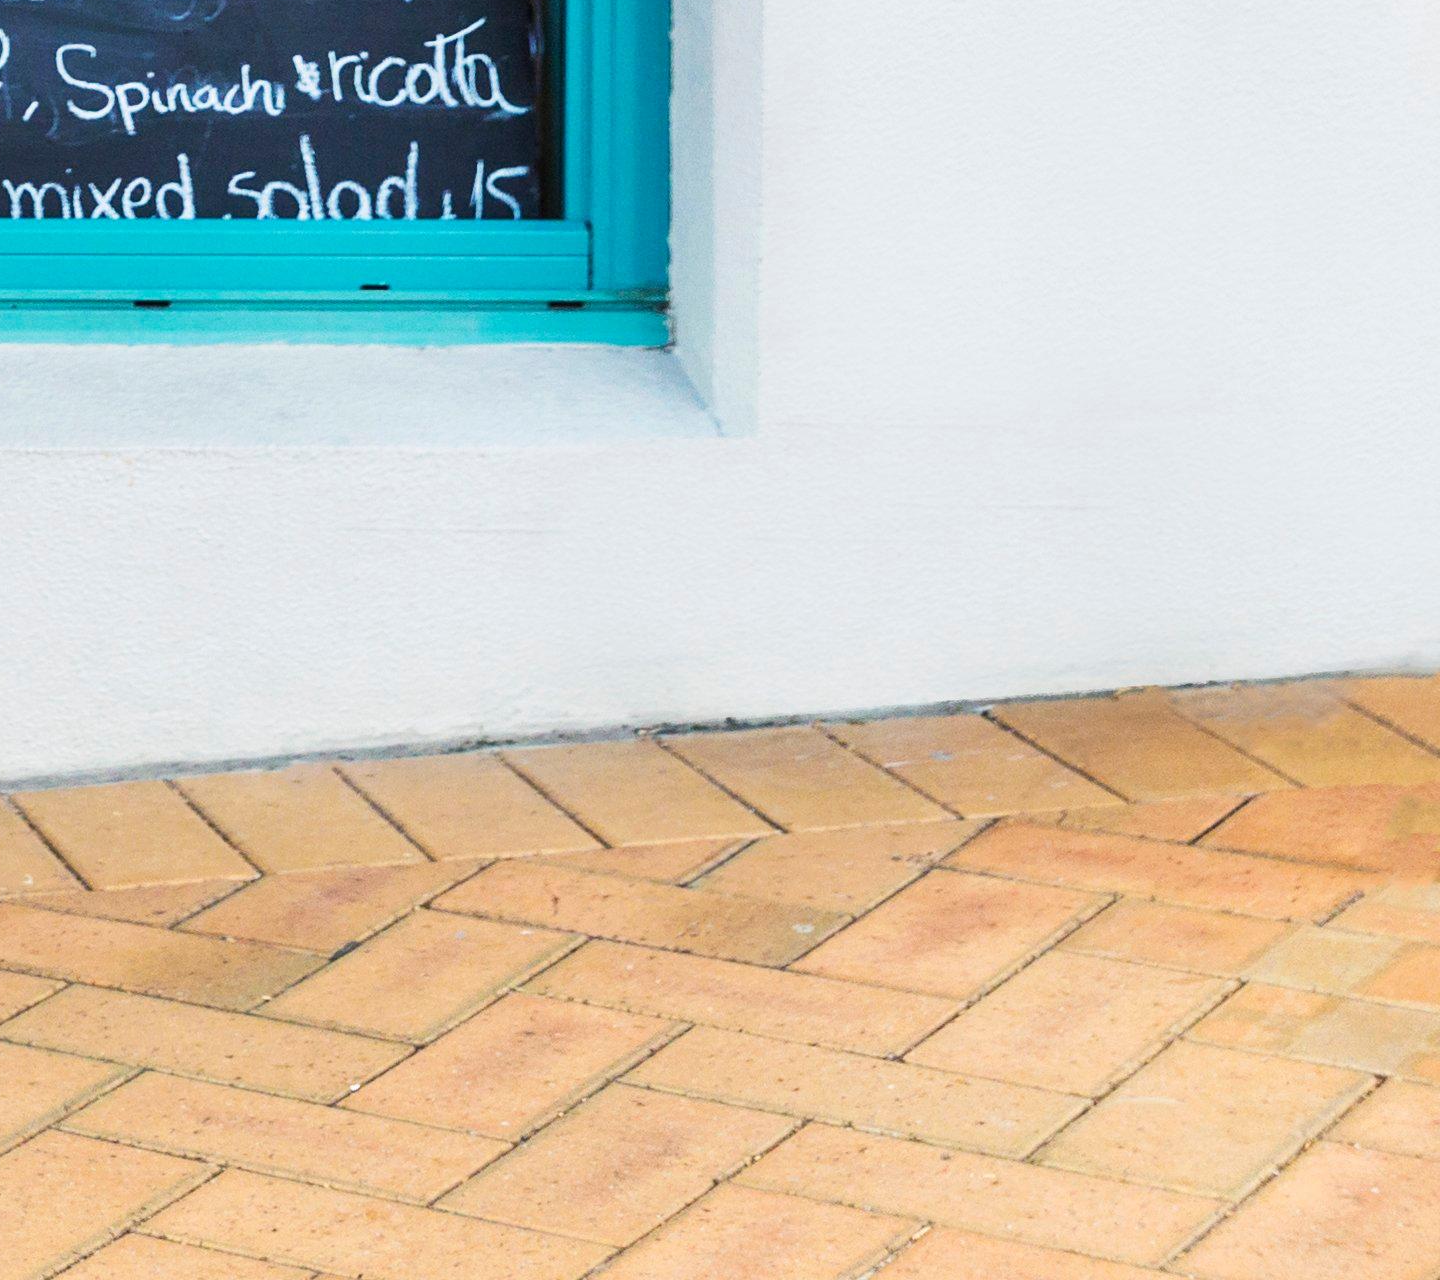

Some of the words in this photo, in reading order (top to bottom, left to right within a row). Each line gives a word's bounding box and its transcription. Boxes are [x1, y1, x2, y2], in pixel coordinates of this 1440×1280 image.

[327, 17, 531, 115] ricotta
[2, 152, 194, 220] mixed
[225, 133, 420, 220] salad
